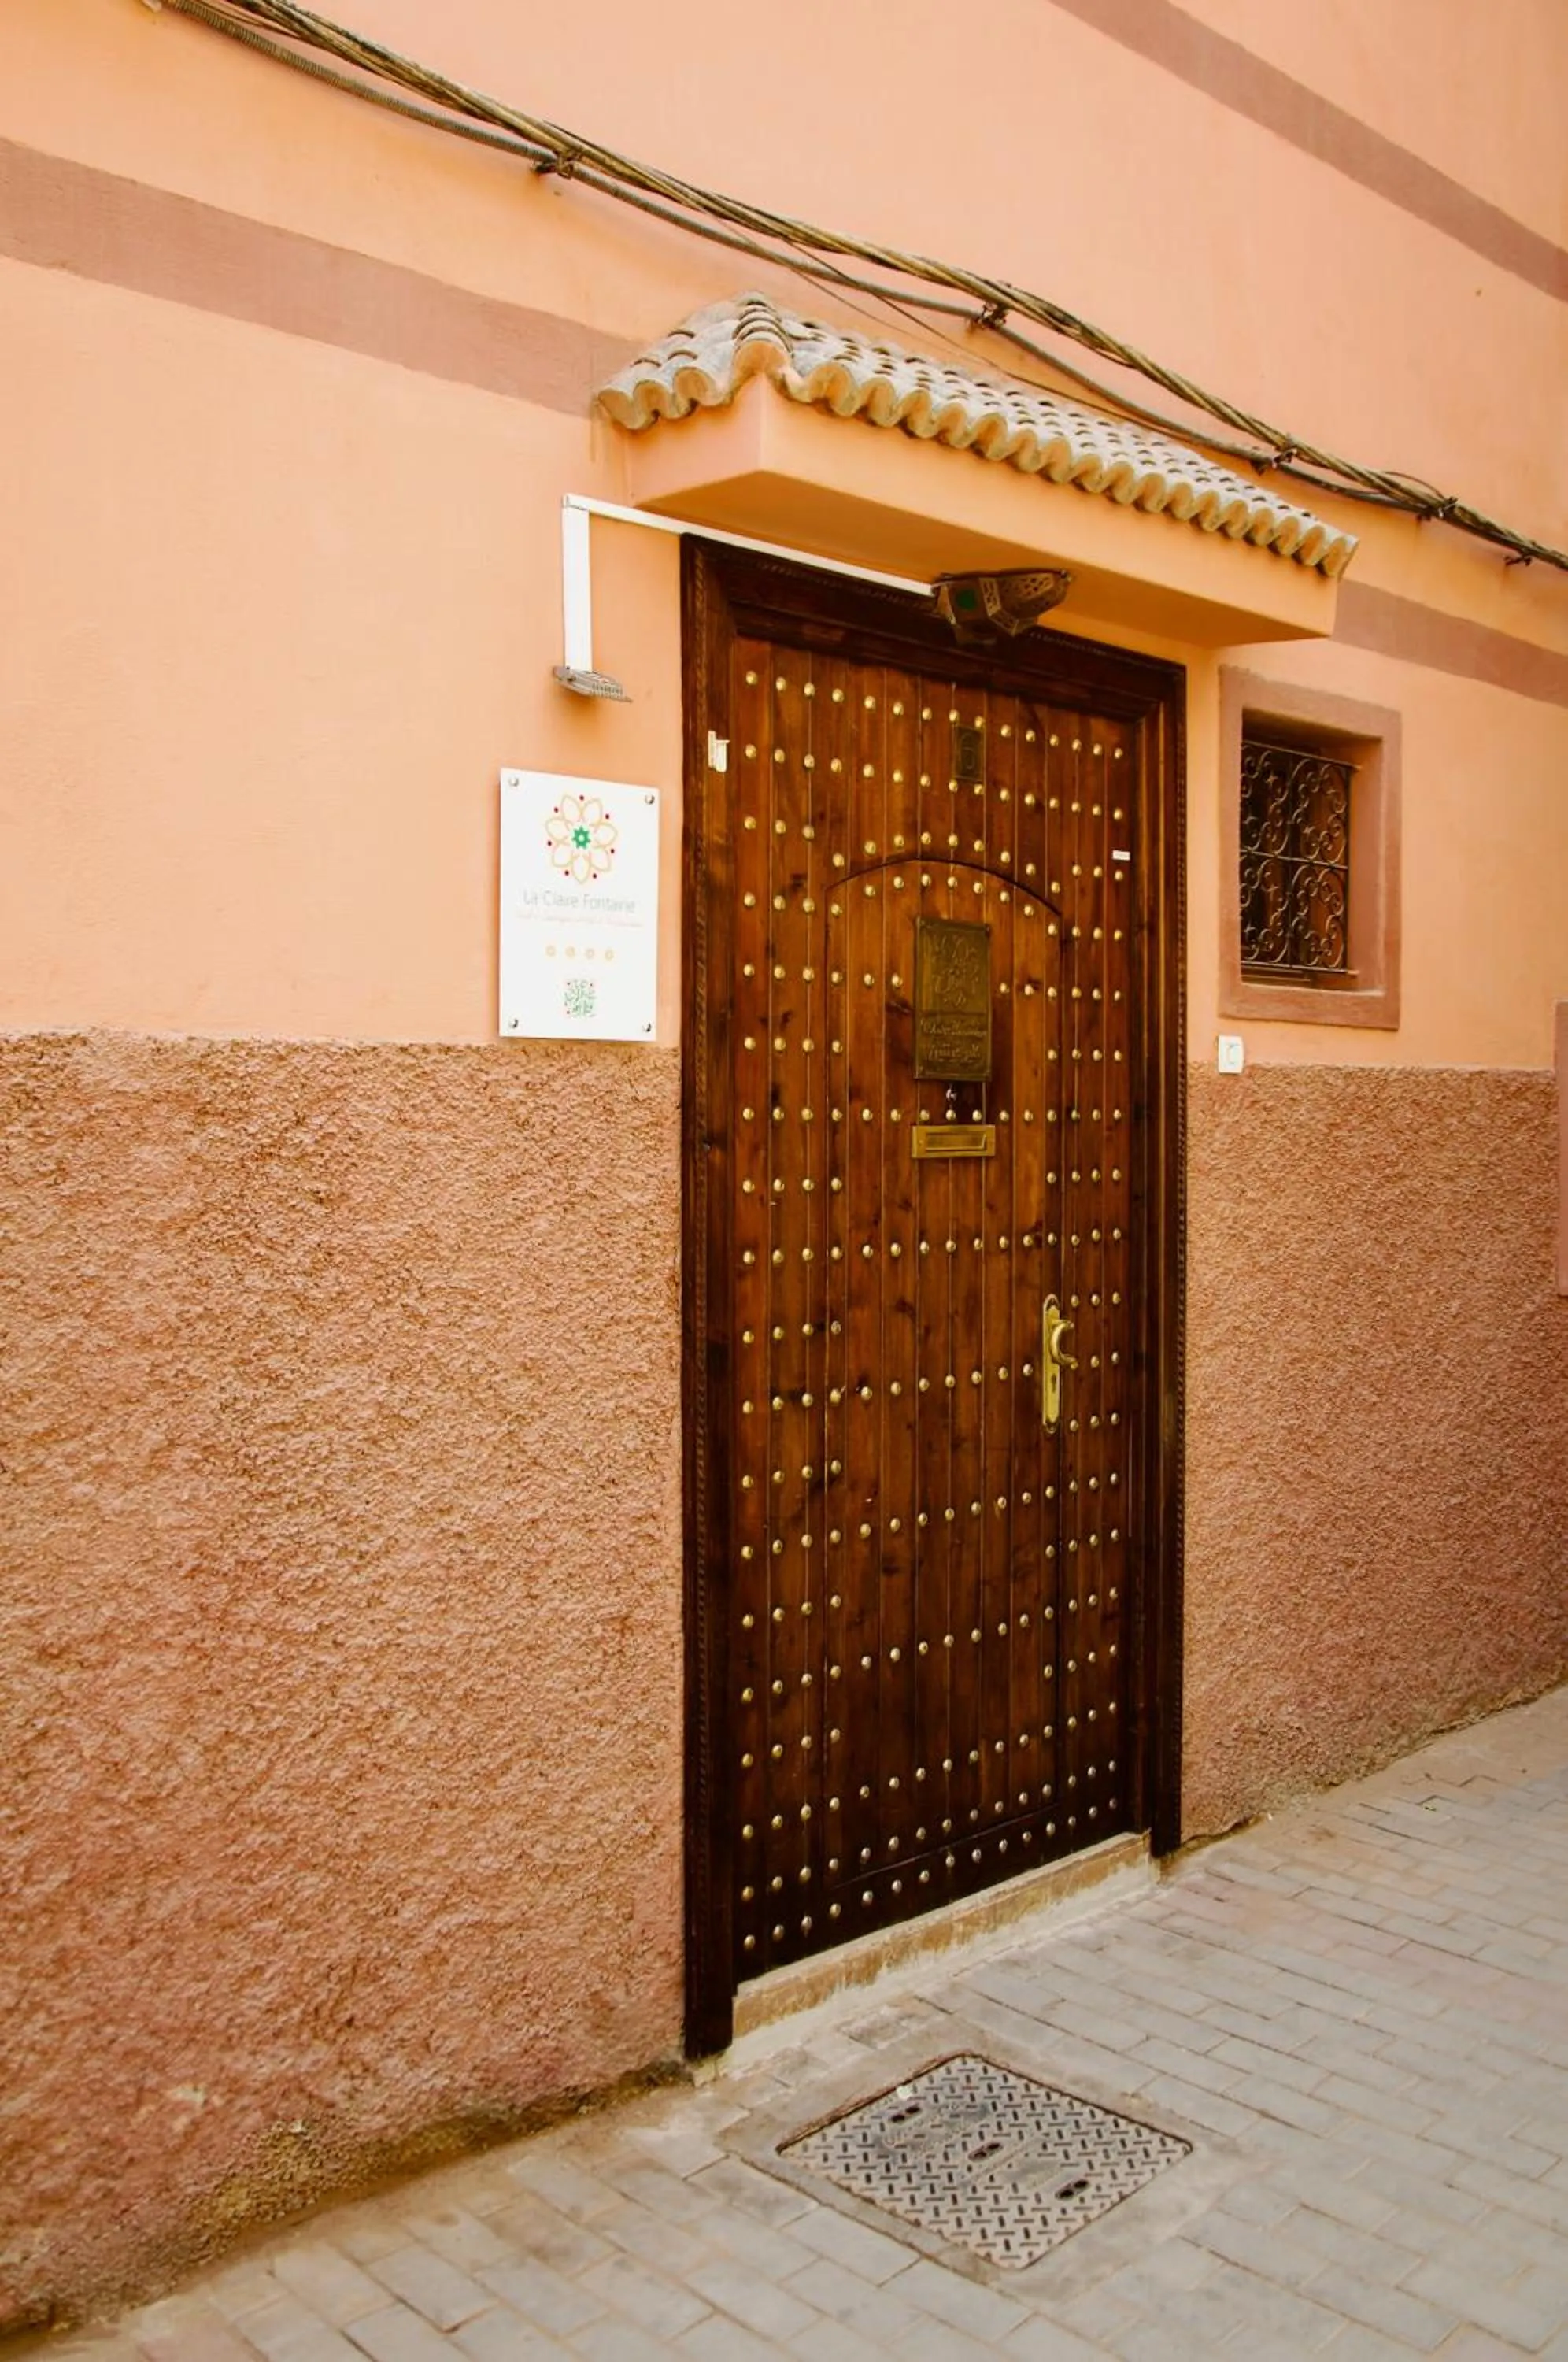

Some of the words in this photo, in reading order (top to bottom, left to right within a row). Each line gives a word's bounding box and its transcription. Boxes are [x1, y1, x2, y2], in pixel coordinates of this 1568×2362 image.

[523, 889, 538, 905] La
[543, 890, 579, 909] Claire
[582, 893, 636, 913] Fontaine
